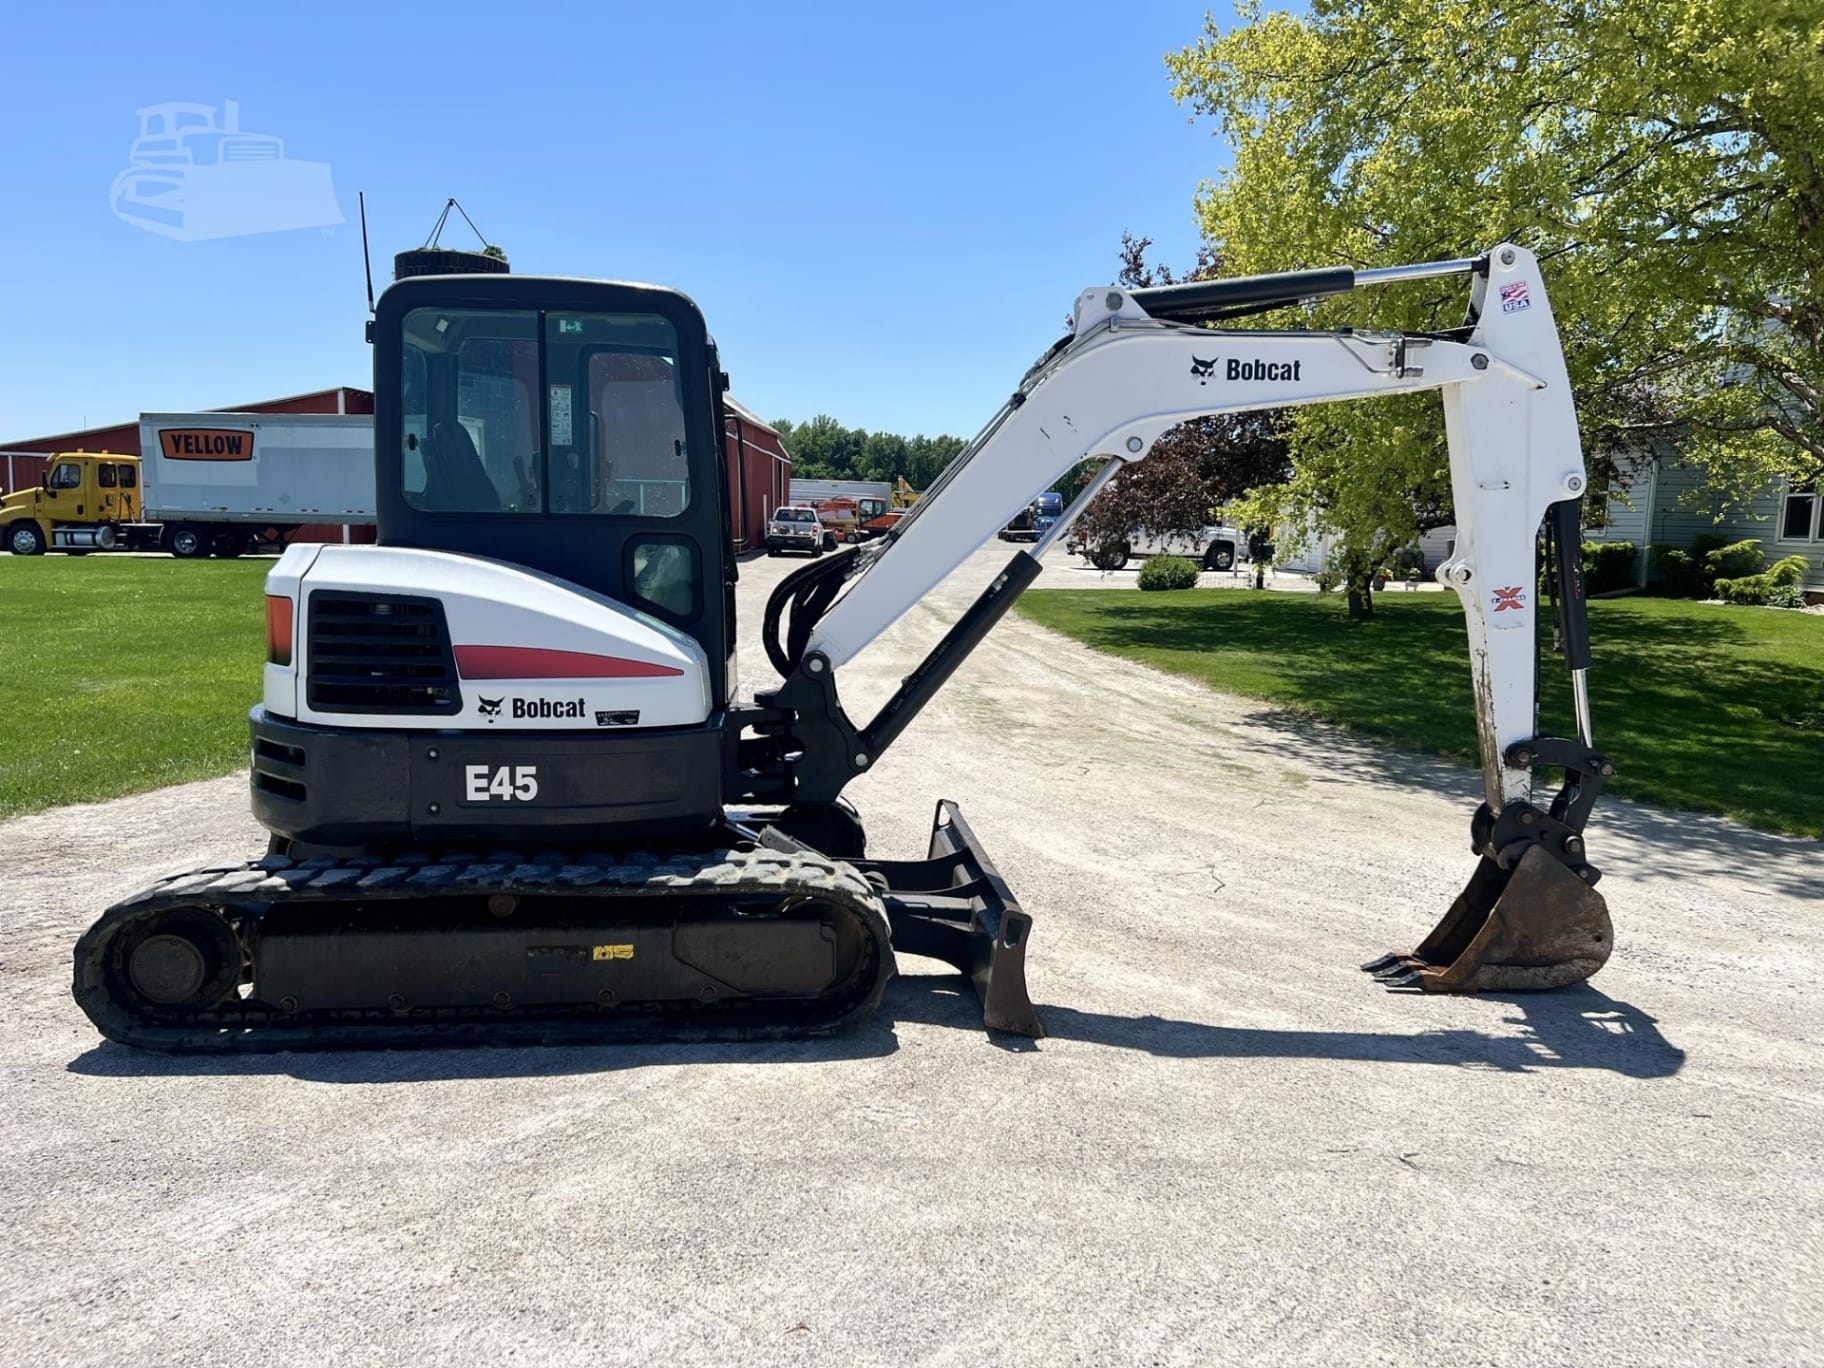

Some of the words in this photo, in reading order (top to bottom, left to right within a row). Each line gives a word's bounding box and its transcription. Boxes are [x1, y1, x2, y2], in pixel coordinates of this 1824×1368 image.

[1504, 299, 1529, 311] USA
[1226, 359, 1301, 381] Bobcat
[171, 434, 242, 455] YELLOW
[512, 698, 586, 718] Bobcat
[465, 765, 538, 801] E45
